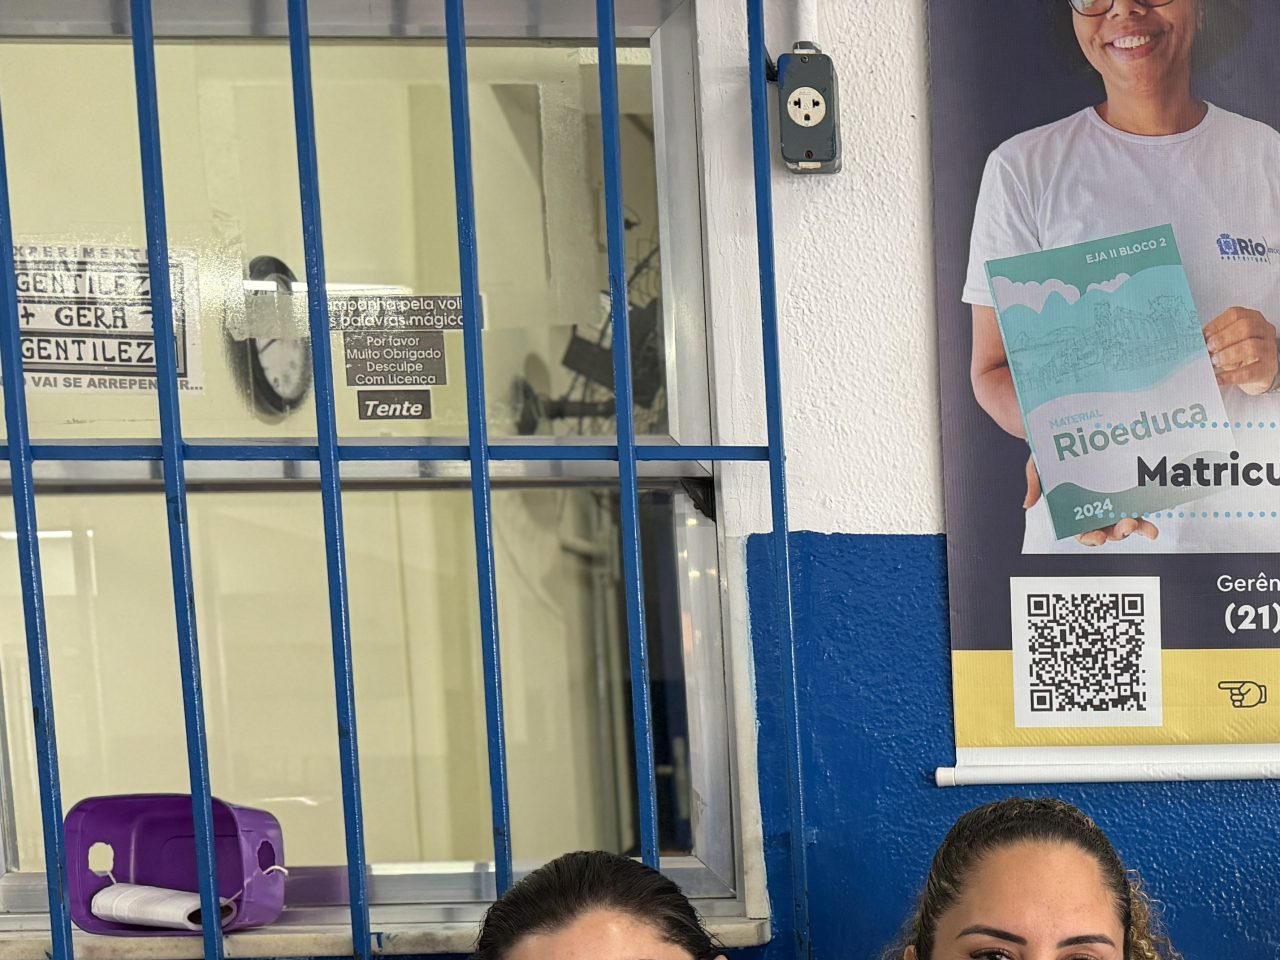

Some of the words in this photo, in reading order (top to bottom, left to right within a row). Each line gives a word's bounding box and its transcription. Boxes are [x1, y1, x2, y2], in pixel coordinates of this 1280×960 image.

[1085, 251, 1108, 264] EJA
[1119, 240, 1157, 257] BLOCO
[1159, 237, 1168, 247] 2
[16, 272, 151, 296] GENTILEZ
[327, 298, 397, 312] ampanha
[400, 297, 434, 312] pela
[55, 306, 128, 329] GERA
[21, 338, 155, 363] GENTILEZ
[367, 336, 385, 347] Por
[388, 336, 419, 347] favor
[347, 349, 380, 359] Muito
[383, 348, 441, 361] Obrigado
[367, 362, 423, 374] Desculpe
[31, 376, 58, 387] VAI
[63, 377, 82, 388] SE
[355, 375, 385, 385] Com
[388, 374, 436, 386] Licença
[365, 400, 423, 417] Tente
[1049, 409, 1104, 429] MATERIAL
[1053, 403, 1208, 462] Rioeduca
[1074, 498, 1113, 520] 2024
